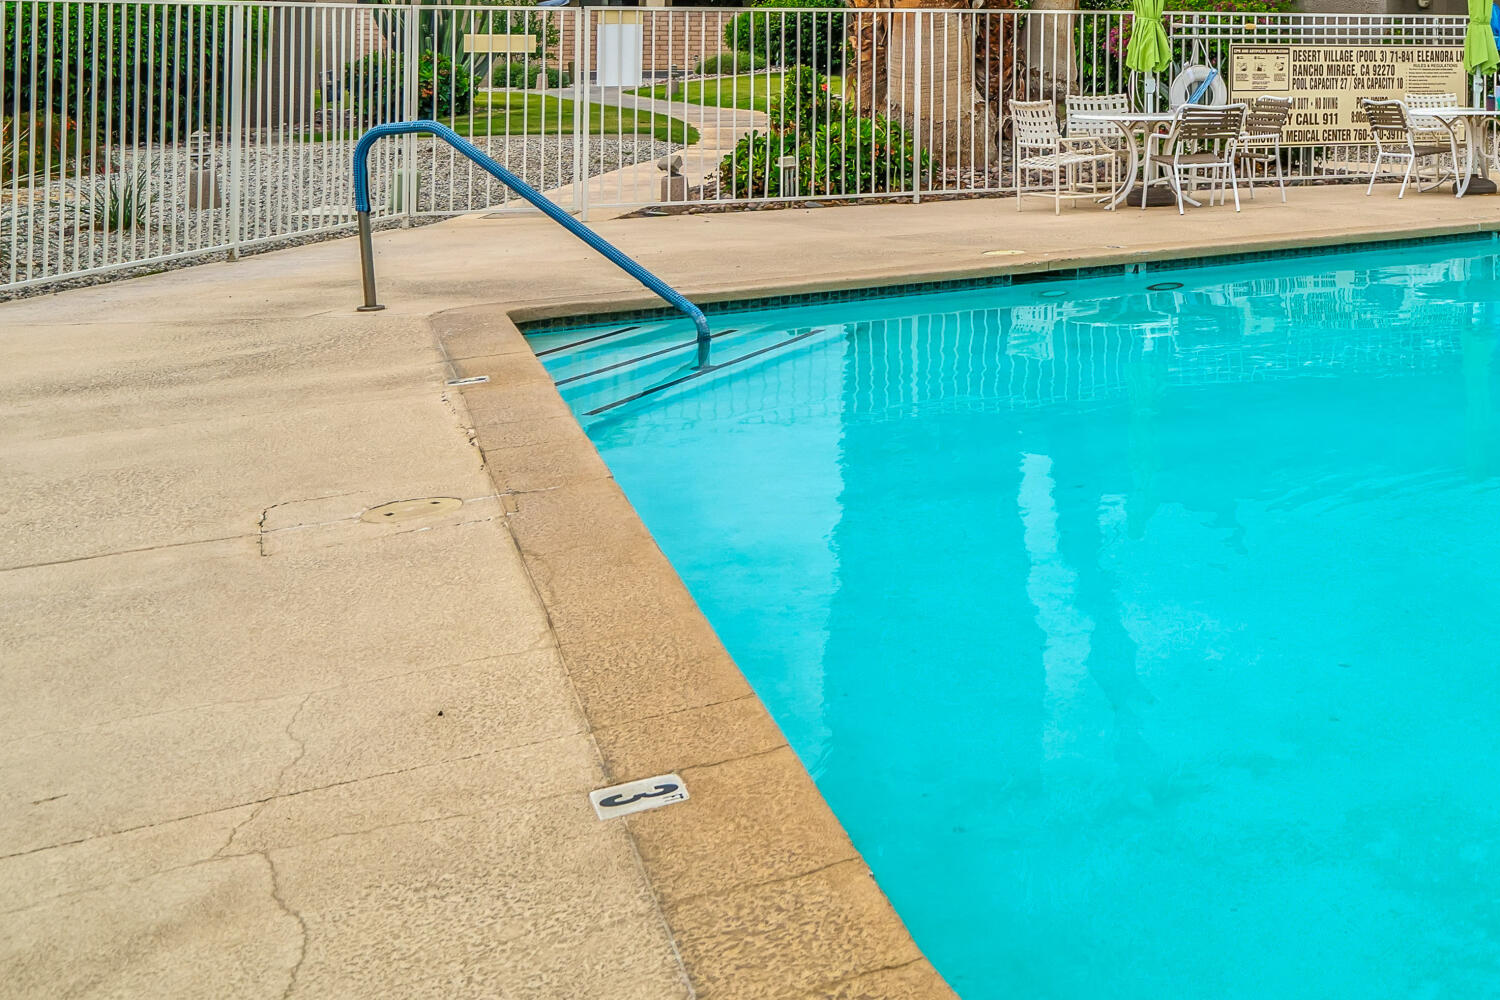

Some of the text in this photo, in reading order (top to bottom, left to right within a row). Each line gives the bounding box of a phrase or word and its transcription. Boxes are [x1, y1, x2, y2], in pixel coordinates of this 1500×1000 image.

[1292, 50, 1321, 62] DESERT
[1323, 50, 1354, 62] VILLAGE
[1356, 50, 1377, 63] (POOL
[1380, 50, 1387, 63] 3)
[1390, 50, 1414, 63] 71-841
[1417, 50, 1454, 62] ELEANORA
[1292, 64, 1395, 77] RANCHO MIRAGE, CA 92270
[1292, 78, 1308, 90] POOL
[1309, 78, 1339, 90] CAPACITY
[1340, 78, 1348, 90] 27
[1353, 78, 1365, 89] SPA
[1366, 77, 1395, 89] CAPACITY
[1397, 77, 1403, 89] 10
[1296, 113, 1320, 125] CALL
[1322, 113, 1338, 125] 911
[1286, 130, 1320, 142] MEDICAL
[1322, 129, 1351, 141] CENTER
[598, 783, 679, 807] 3
